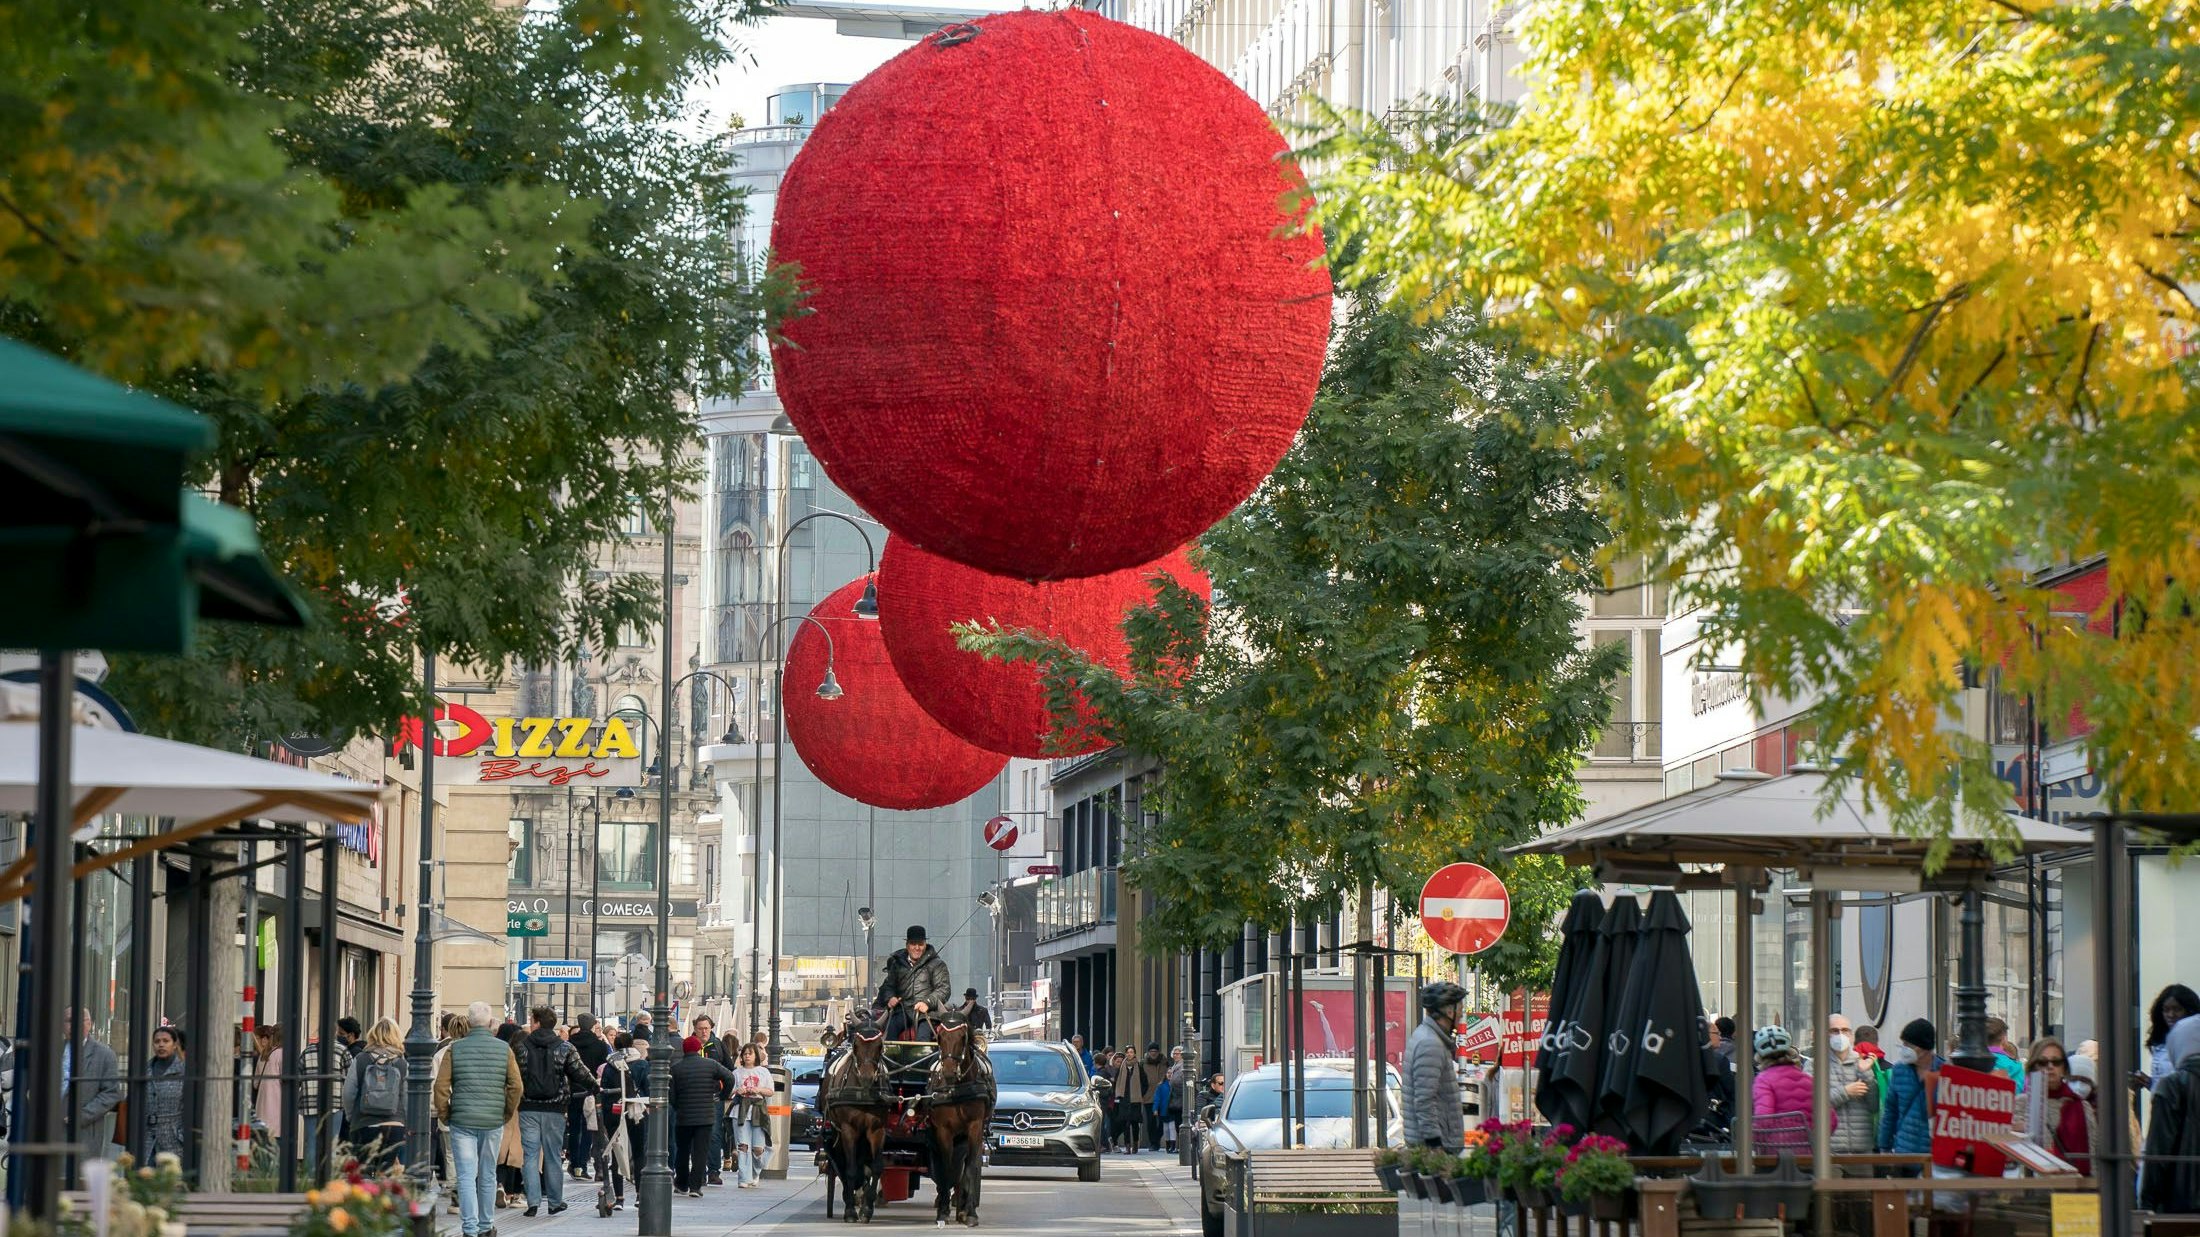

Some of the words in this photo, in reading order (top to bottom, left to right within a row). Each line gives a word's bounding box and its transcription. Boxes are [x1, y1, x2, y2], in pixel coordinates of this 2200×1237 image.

[480, 759, 610, 785] Bizi
[507, 900, 528, 913] GA
[601, 902, 654, 916] OMEGA
[507, 918, 521, 929] rle
[540, 967, 580, 977] EINBAHN
[1467, 1030, 1494, 1047] RIER
[1936, 1075, 2014, 1112] Kronen
